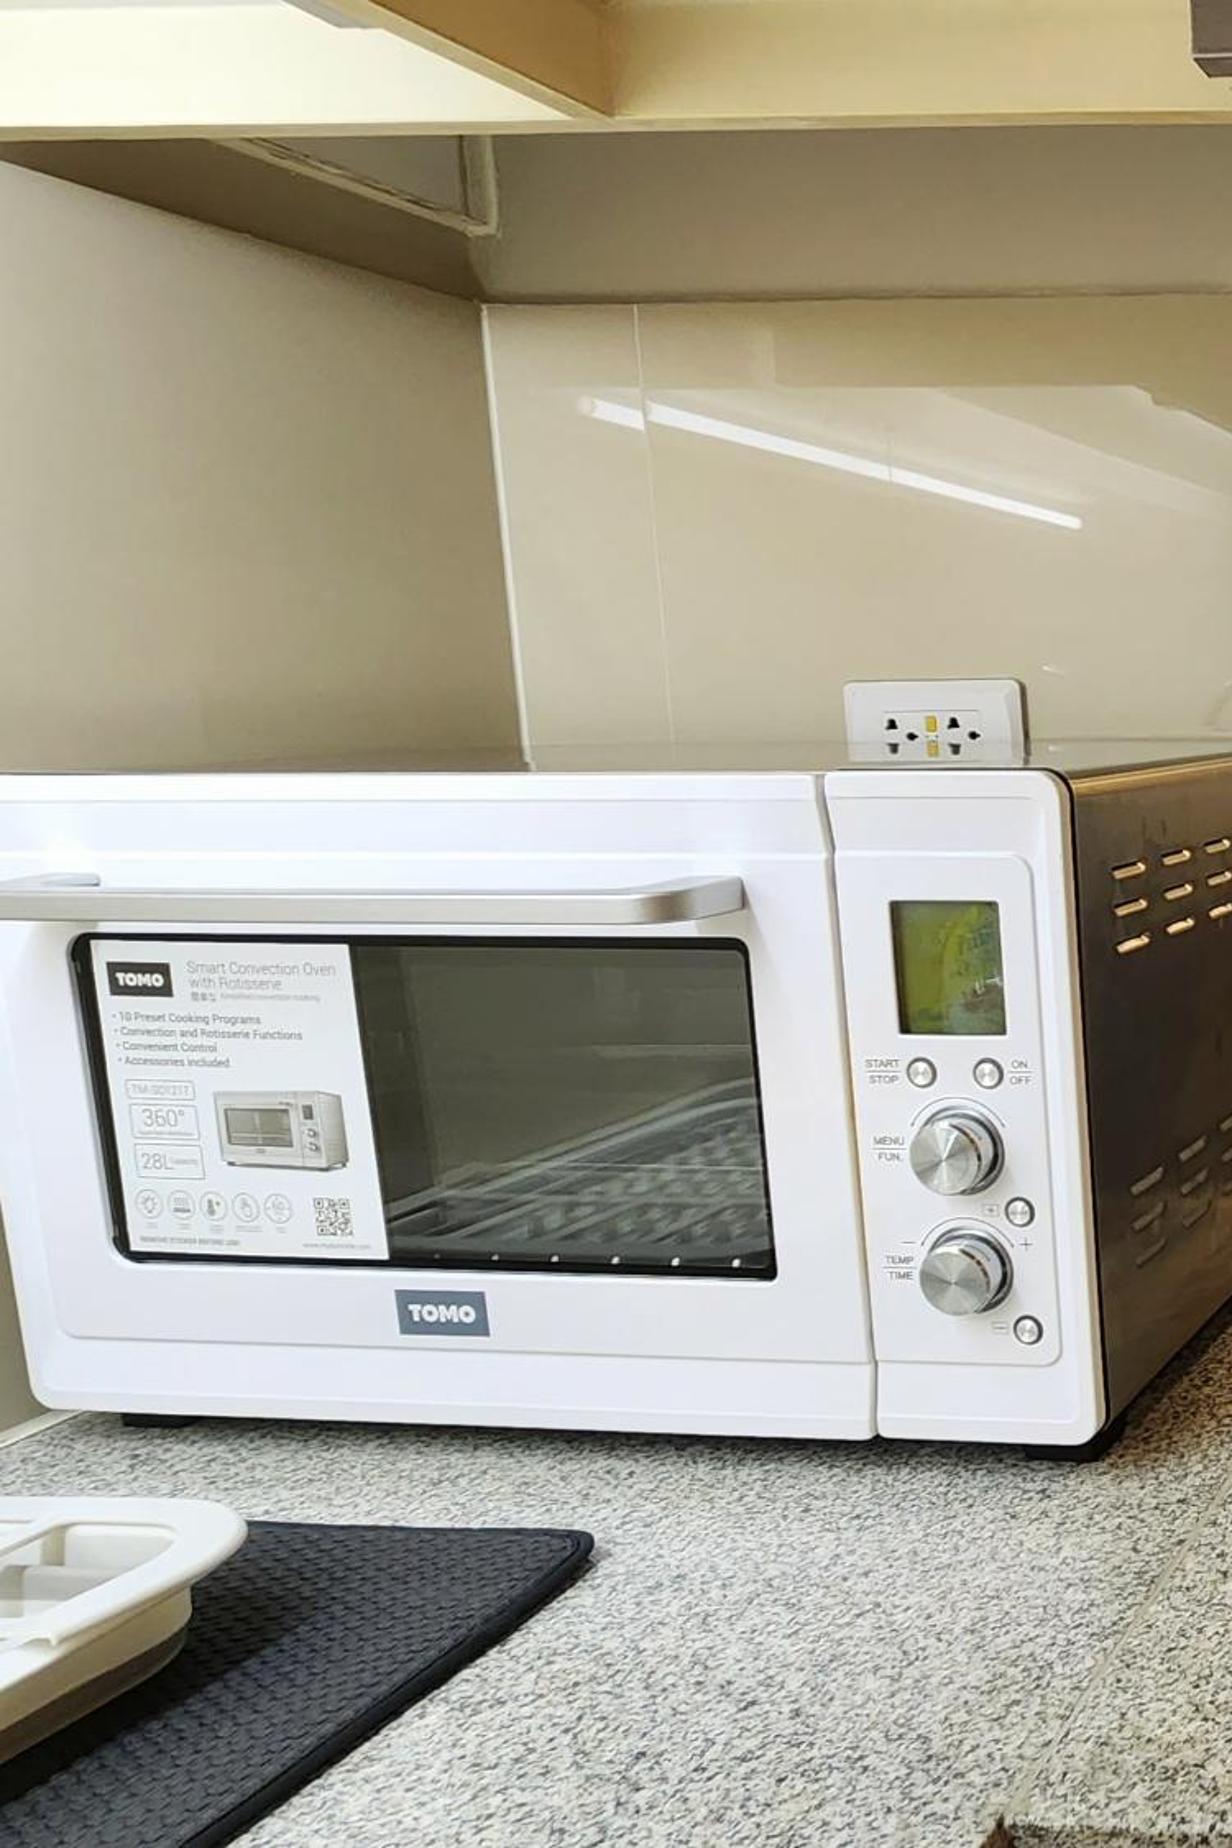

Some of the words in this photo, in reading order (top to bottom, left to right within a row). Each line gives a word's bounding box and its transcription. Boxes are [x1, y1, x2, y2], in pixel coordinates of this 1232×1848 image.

[186, 961, 225, 975] Smart
[229, 962, 299, 976] Convection
[303, 963, 336, 976] Oven
[115, 971, 165, 987] TOMO
[190, 976, 216, 989] with
[219, 977, 282, 991] Rotisserie
[119, 1011, 133, 1022] 10
[135, 1012, 166, 1022] Preset
[168, 1013, 210, 1026] Cooking
[212, 1014, 261, 1027] Programs
[119, 1027, 176, 1038] Convection
[179, 1028, 198, 1038] and
[253, 1030, 303, 1041] Functions
[122, 1042, 178, 1052] Convenient
[181, 1043, 218, 1053] Control
[124, 1057, 185, 1068] Accessories
[865, 1059, 900, 1069] START
[1011, 1059, 1028, 1069] ON
[869, 1075, 900, 1085] STOP
[1010, 1075, 1032, 1085] OFF
[873, 1136, 905, 1147] MENU
[141, 1152, 175, 1170] 28L
[885, 1255, 914, 1265] TEMP
[888, 1270, 914, 1280] TIME
[408, 1303, 477, 1324] TOMO
